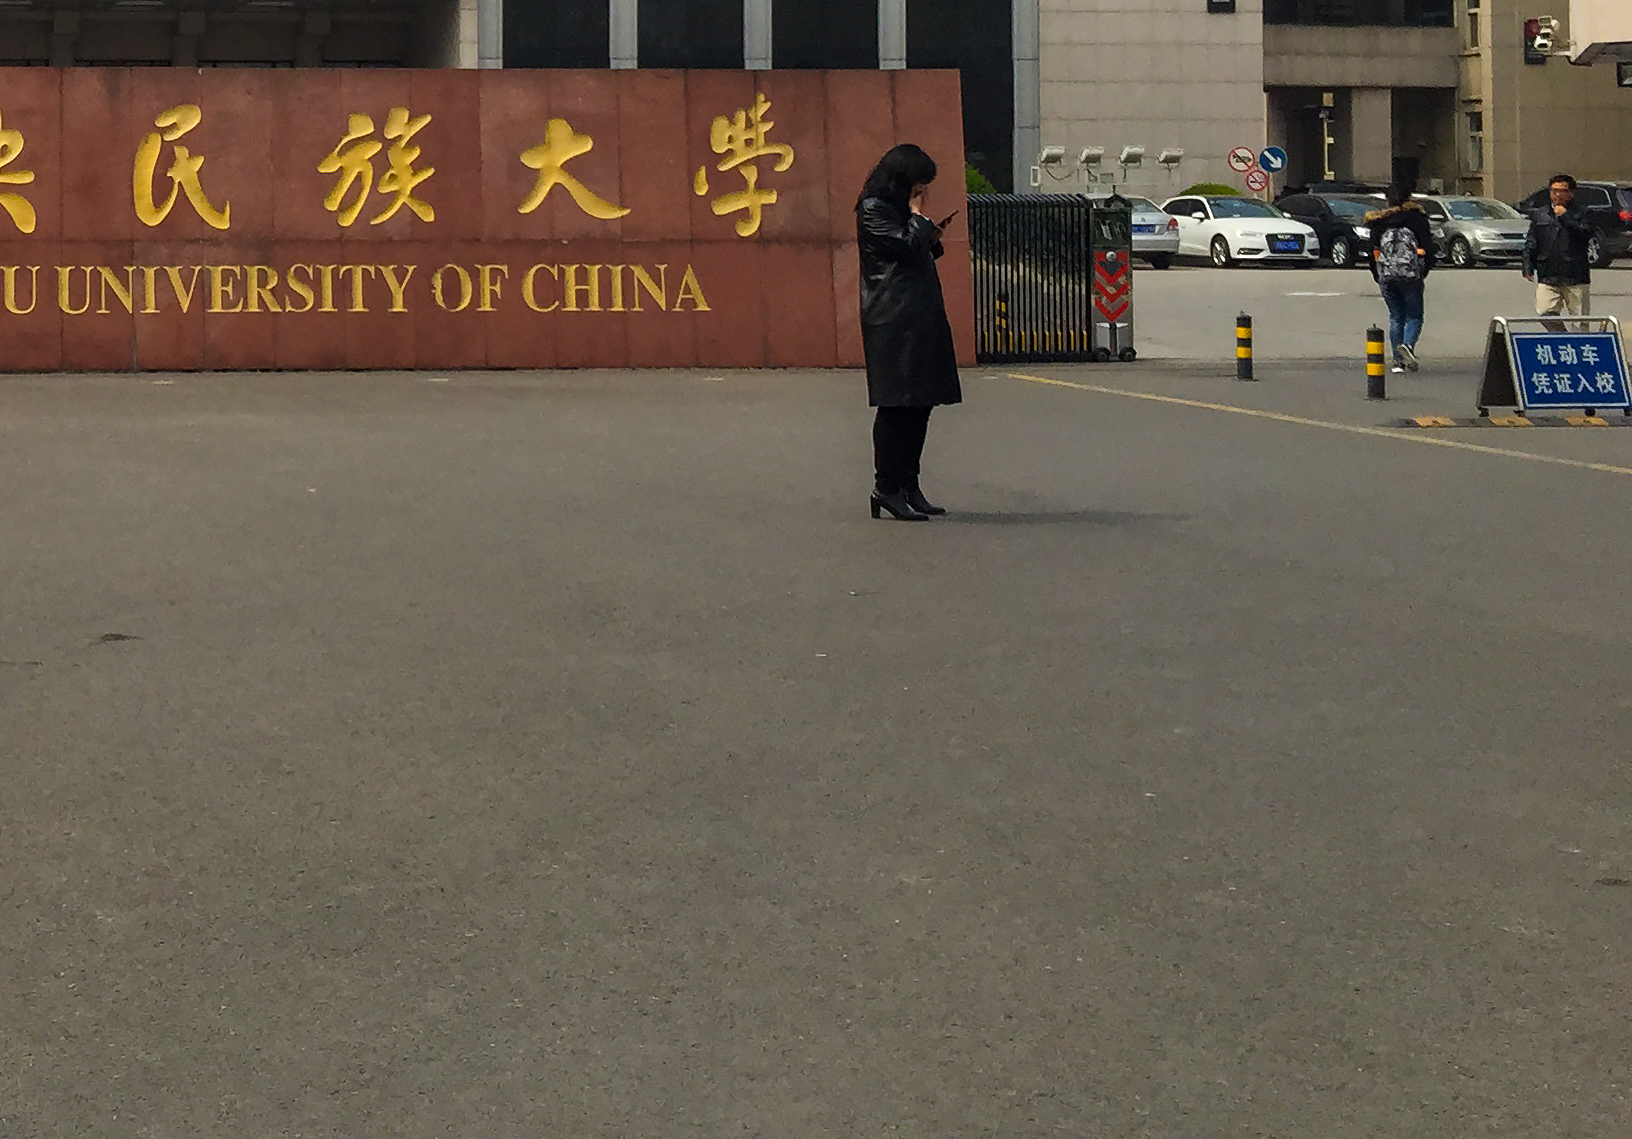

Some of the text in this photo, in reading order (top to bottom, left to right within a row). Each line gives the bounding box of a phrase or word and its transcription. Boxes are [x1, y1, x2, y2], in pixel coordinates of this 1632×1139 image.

[55, 264, 417, 317] UNIVERSITY
[428, 263, 509, 314] OF
[520, 262, 711, 314] CHINA
[1534, 343, 1600, 366] 机动车
[1531, 371, 1617, 395] 凭证入校
